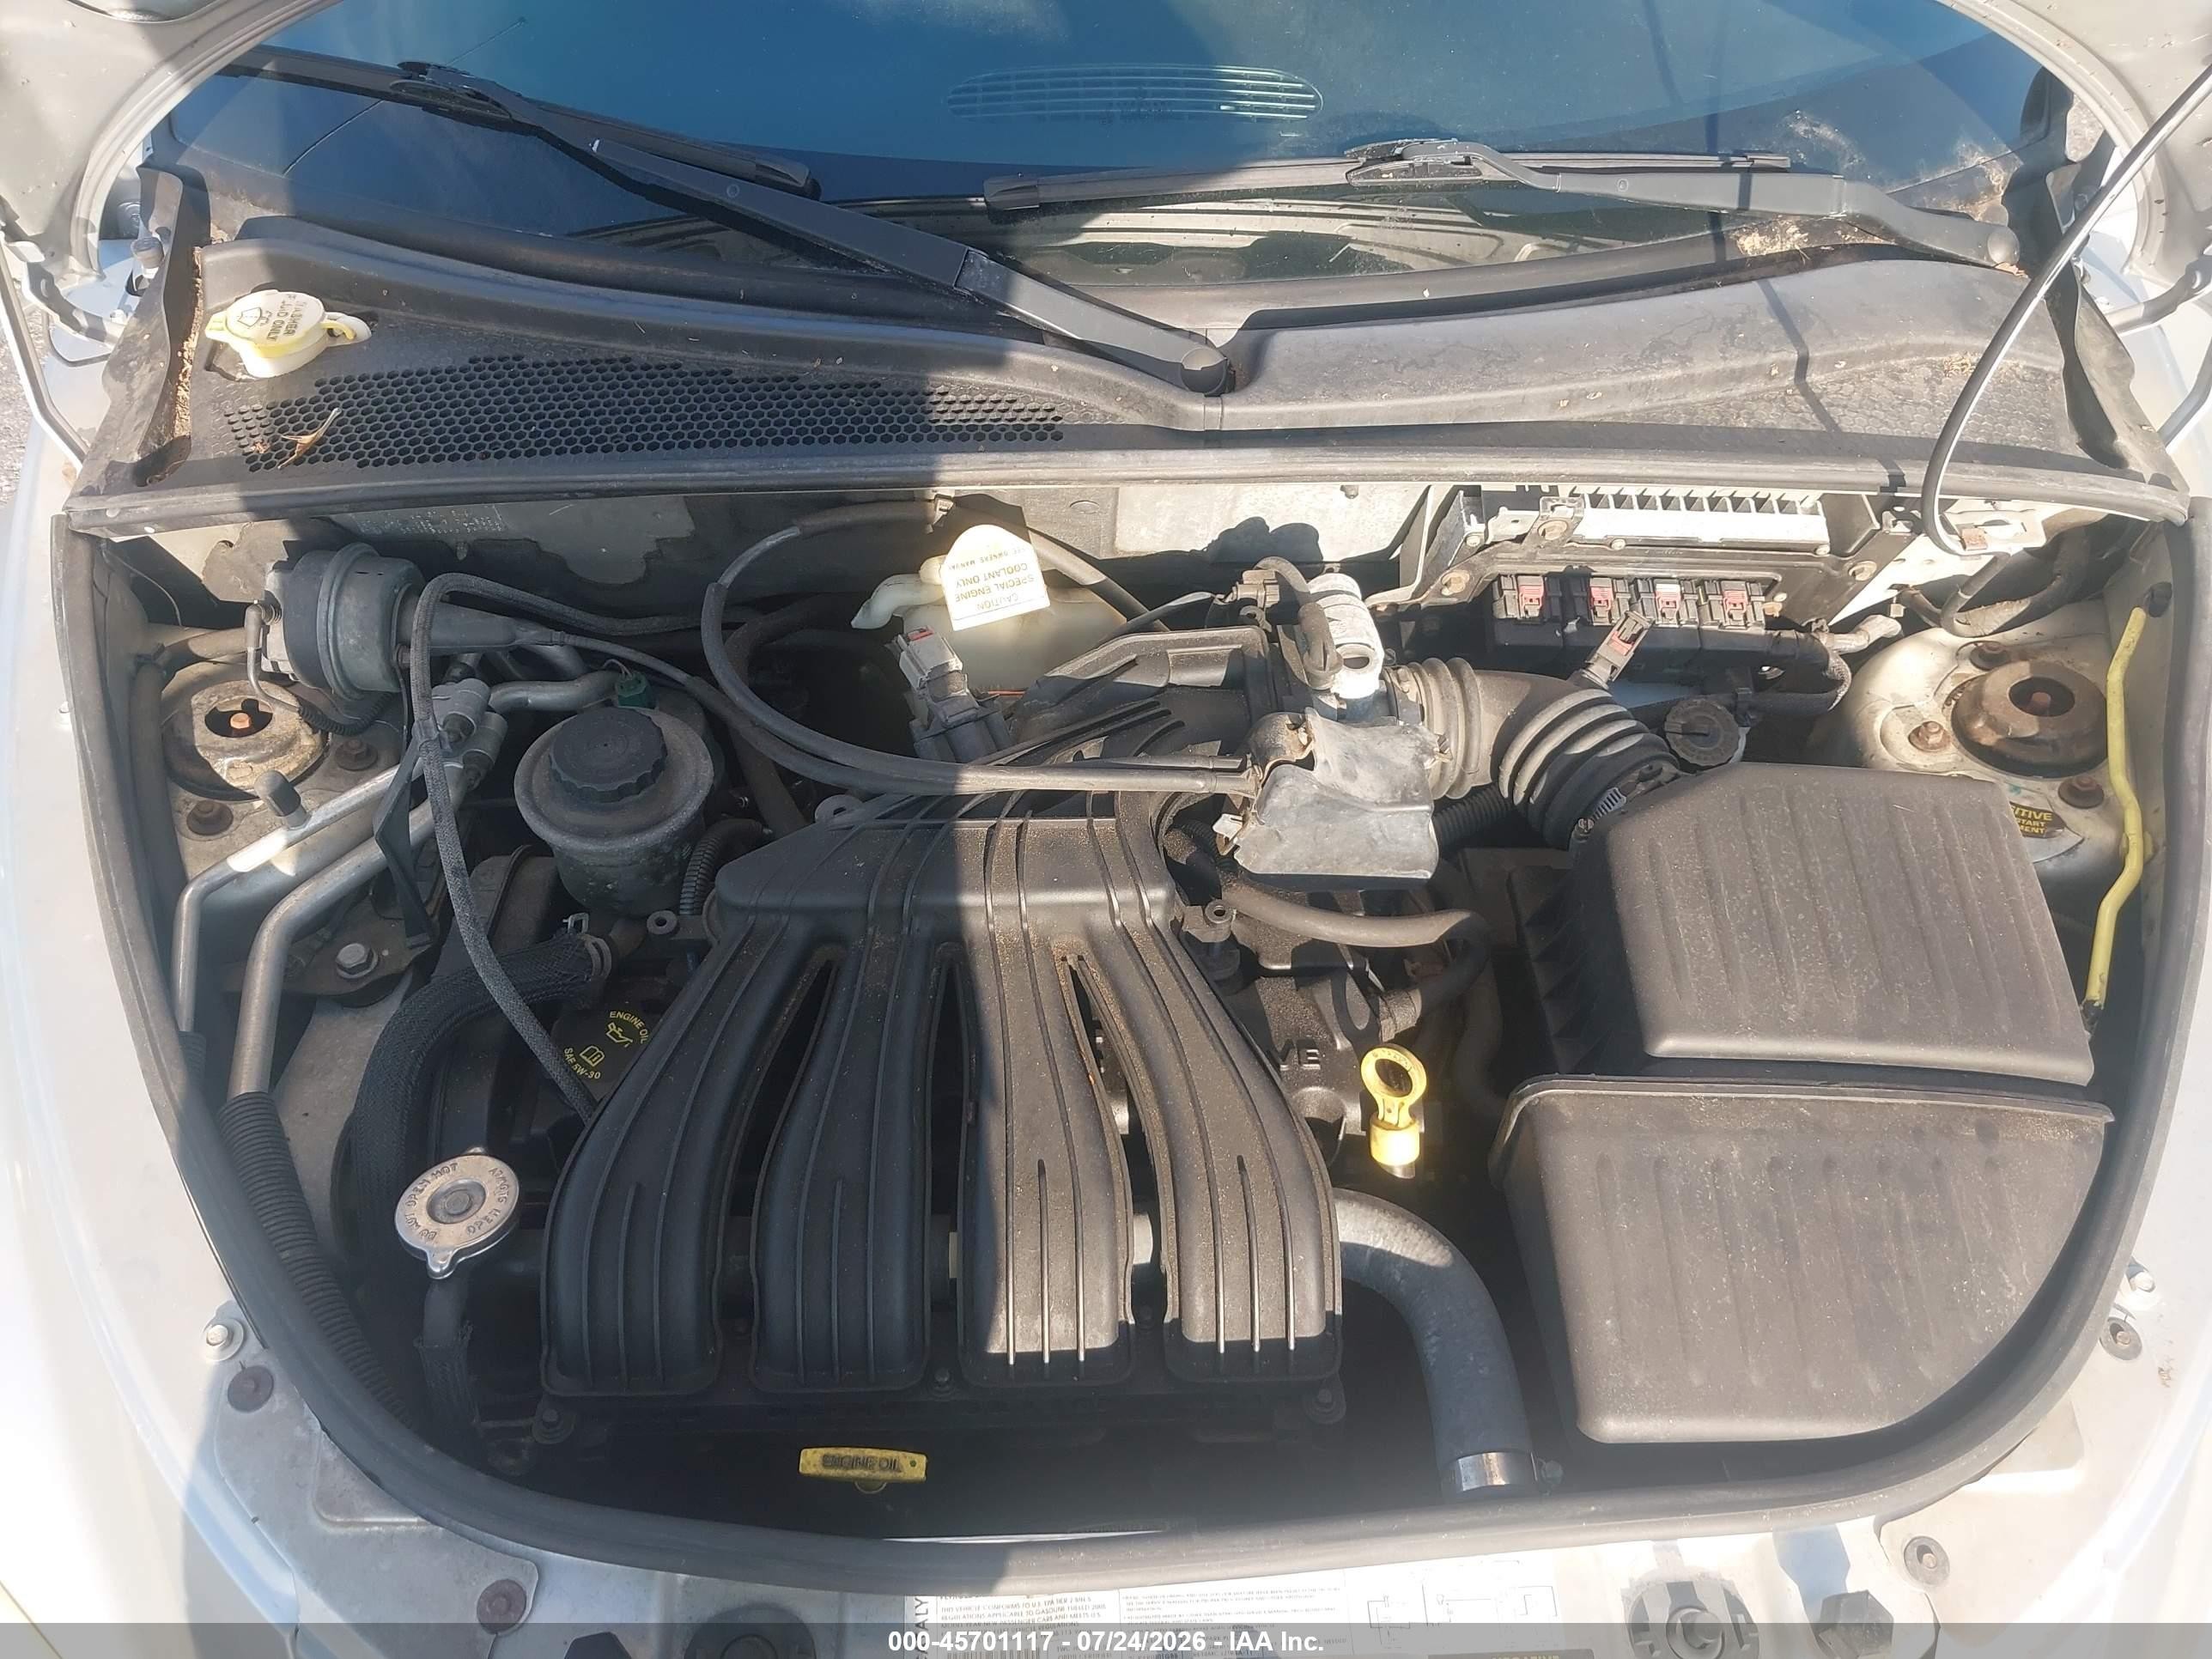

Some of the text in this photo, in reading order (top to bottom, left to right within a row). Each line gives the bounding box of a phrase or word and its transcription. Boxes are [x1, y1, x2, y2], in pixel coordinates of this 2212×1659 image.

[266, 319, 285, 342] ONLY
[283, 301, 307, 337] WASHER
[955, 574, 1035, 602] SPECIAL ENGINE
[956, 562, 1028, 588] COOLANT ONLY
[977, 592, 1019, 611] CAUTION
[2011, 806, 2052, 821] ITIVE
[609, 1011, 651, 1044] ENGINE OIL
[564, 1048, 601, 1079] SAE 5W-30
[404, 1163, 459, 1241] DO NOT OPEN HOT
[466, 1207, 501, 1236] OPEN
[822, 1454, 902, 1472] ENGINE OIL
